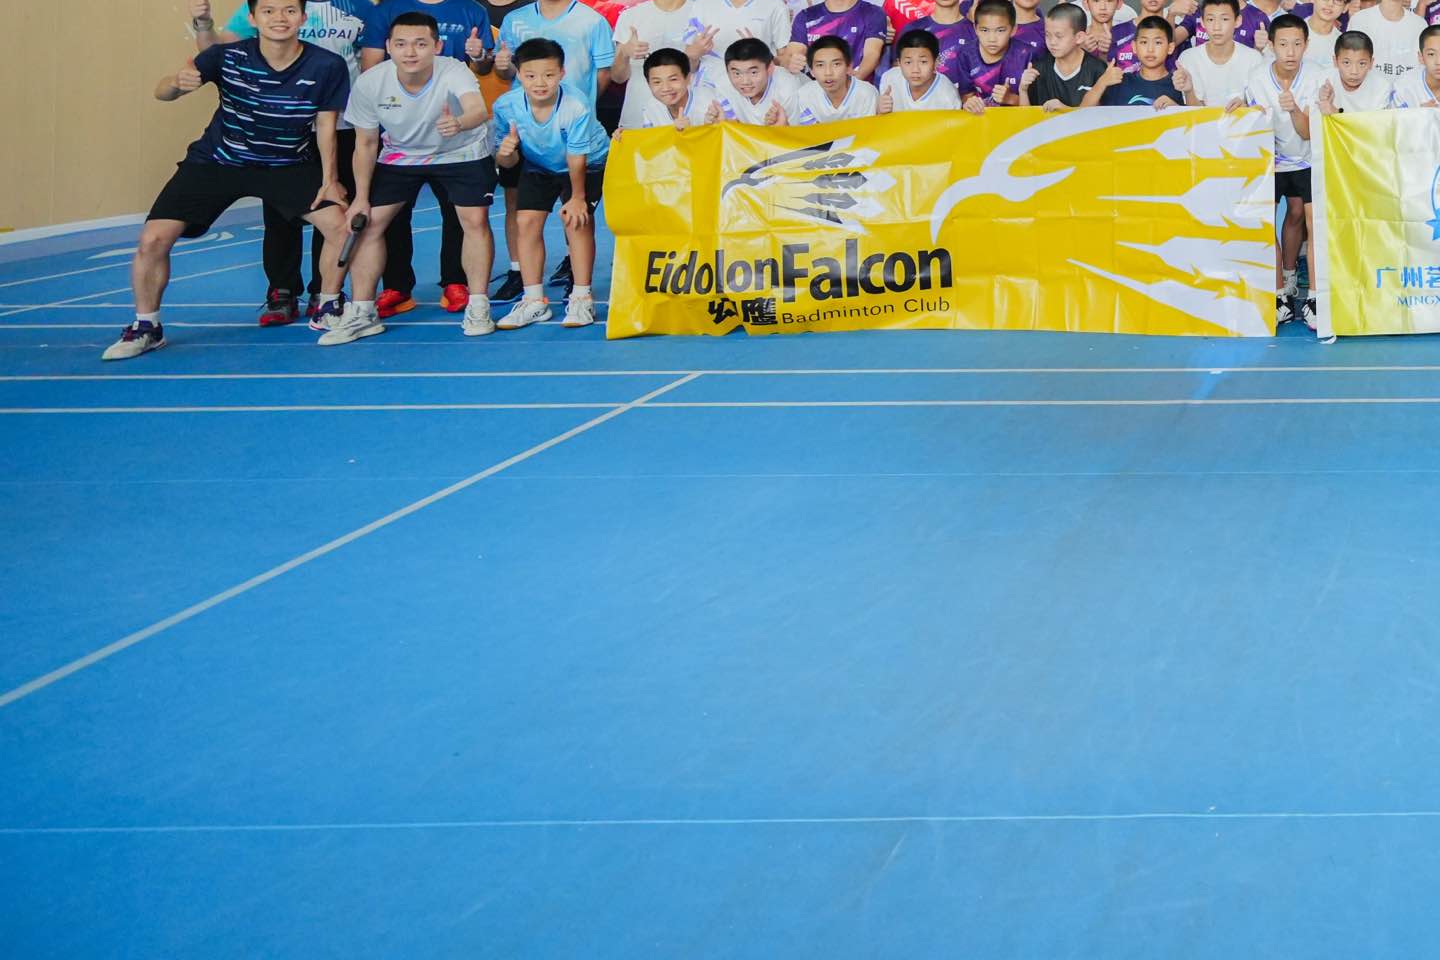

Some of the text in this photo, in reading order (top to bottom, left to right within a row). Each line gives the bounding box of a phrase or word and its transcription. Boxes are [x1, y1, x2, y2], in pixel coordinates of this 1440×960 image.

[297, 28, 352, 39] HAOPAI
[782, 302, 894, 325] Badminton
[904, 296, 950, 313] Club
